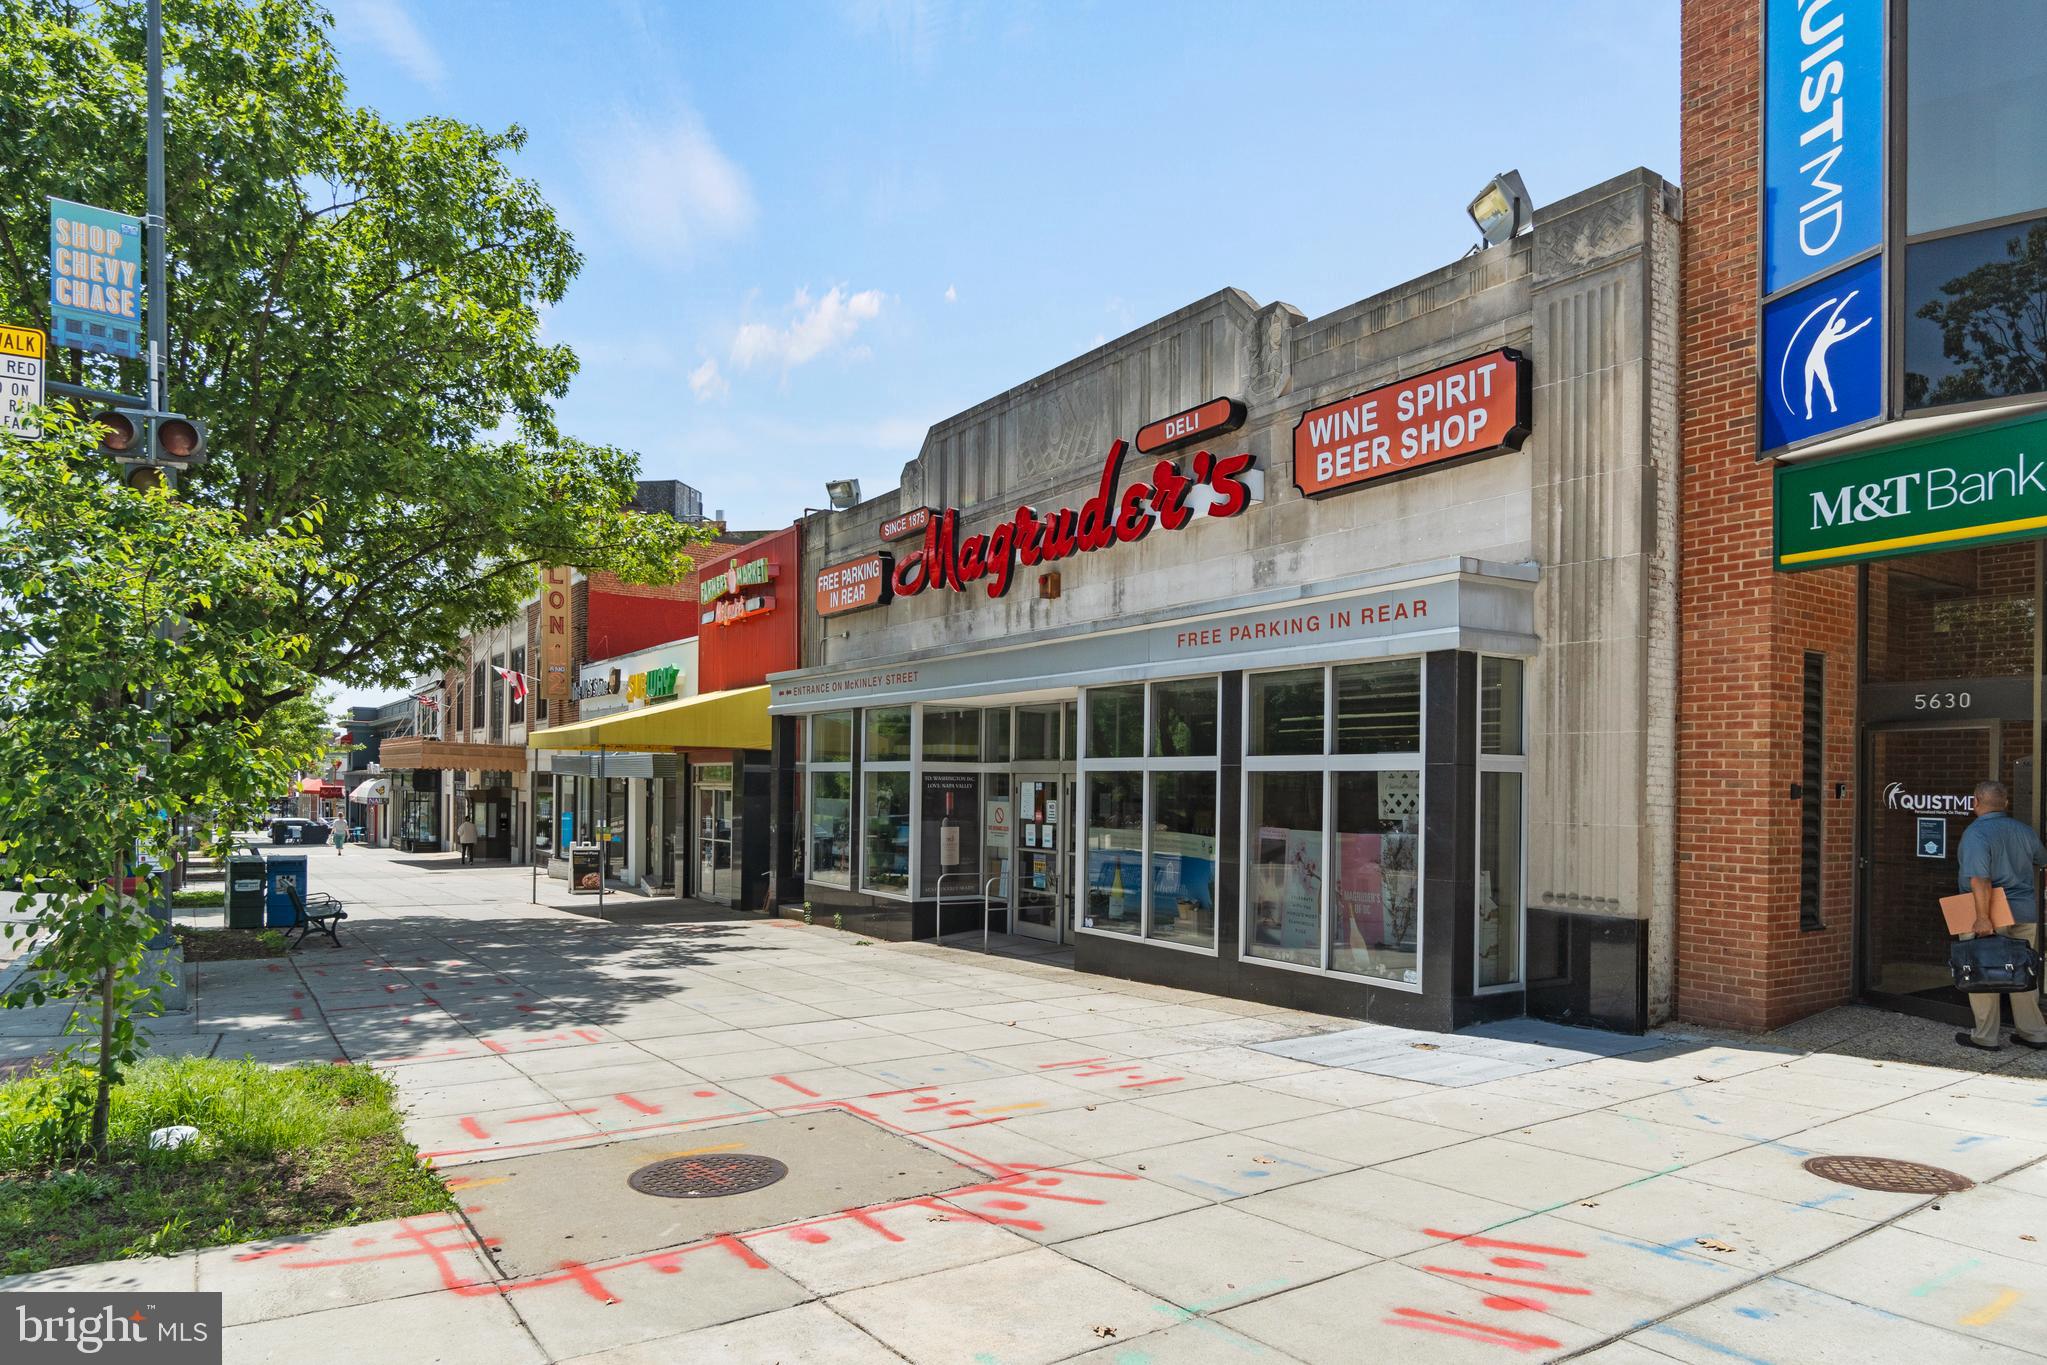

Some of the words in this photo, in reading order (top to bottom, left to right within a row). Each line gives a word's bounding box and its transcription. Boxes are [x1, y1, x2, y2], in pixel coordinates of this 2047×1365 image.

[1798, 0, 1844, 256] UISTMD
[56, 217, 122, 256] SHOP
[56, 247, 136, 288] CHEVY
[56, 277, 135, 317] CHASE
[0, 333, 35, 352] ALK
[7, 360, 36, 376] RED
[11, 383, 29, 397] ON
[1309, 401, 1378, 448] WINE
[1396, 363, 1498, 422] SPIRIT
[1165, 412, 1200, 440] DELI
[1316, 435, 1391, 482] BEER
[1400, 408, 1488, 459] SHOP
[1809, 473, 1920, 530] M&T
[1927, 453, 2047, 510] Bank
[884, 518, 906, 536] SINCE
[908, 511, 925, 526] 1875
[892, 438, 1256, 598] Magruder's
[736, 557, 768, 585] MARKET
[817, 572, 839, 592] FREE
[841, 560, 880, 586] PARKING
[830, 592, 838, 608] IN
[841, 583, 866, 605] REAR
[1177, 629, 1222, 648] FREE
[1229, 615, 1320, 641] PARKING
[1329, 610, 1351, 628] IN
[1361, 599, 1428, 625] REAR
[626, 663, 680, 703] SUBWAY
[793, 683, 830, 696] ENTRANCE
[832, 681, 843, 690] ON
[844, 675, 882, 690] McKINLEY
[885, 671, 919, 685] STREET
[1914, 692, 1971, 710] 5630
